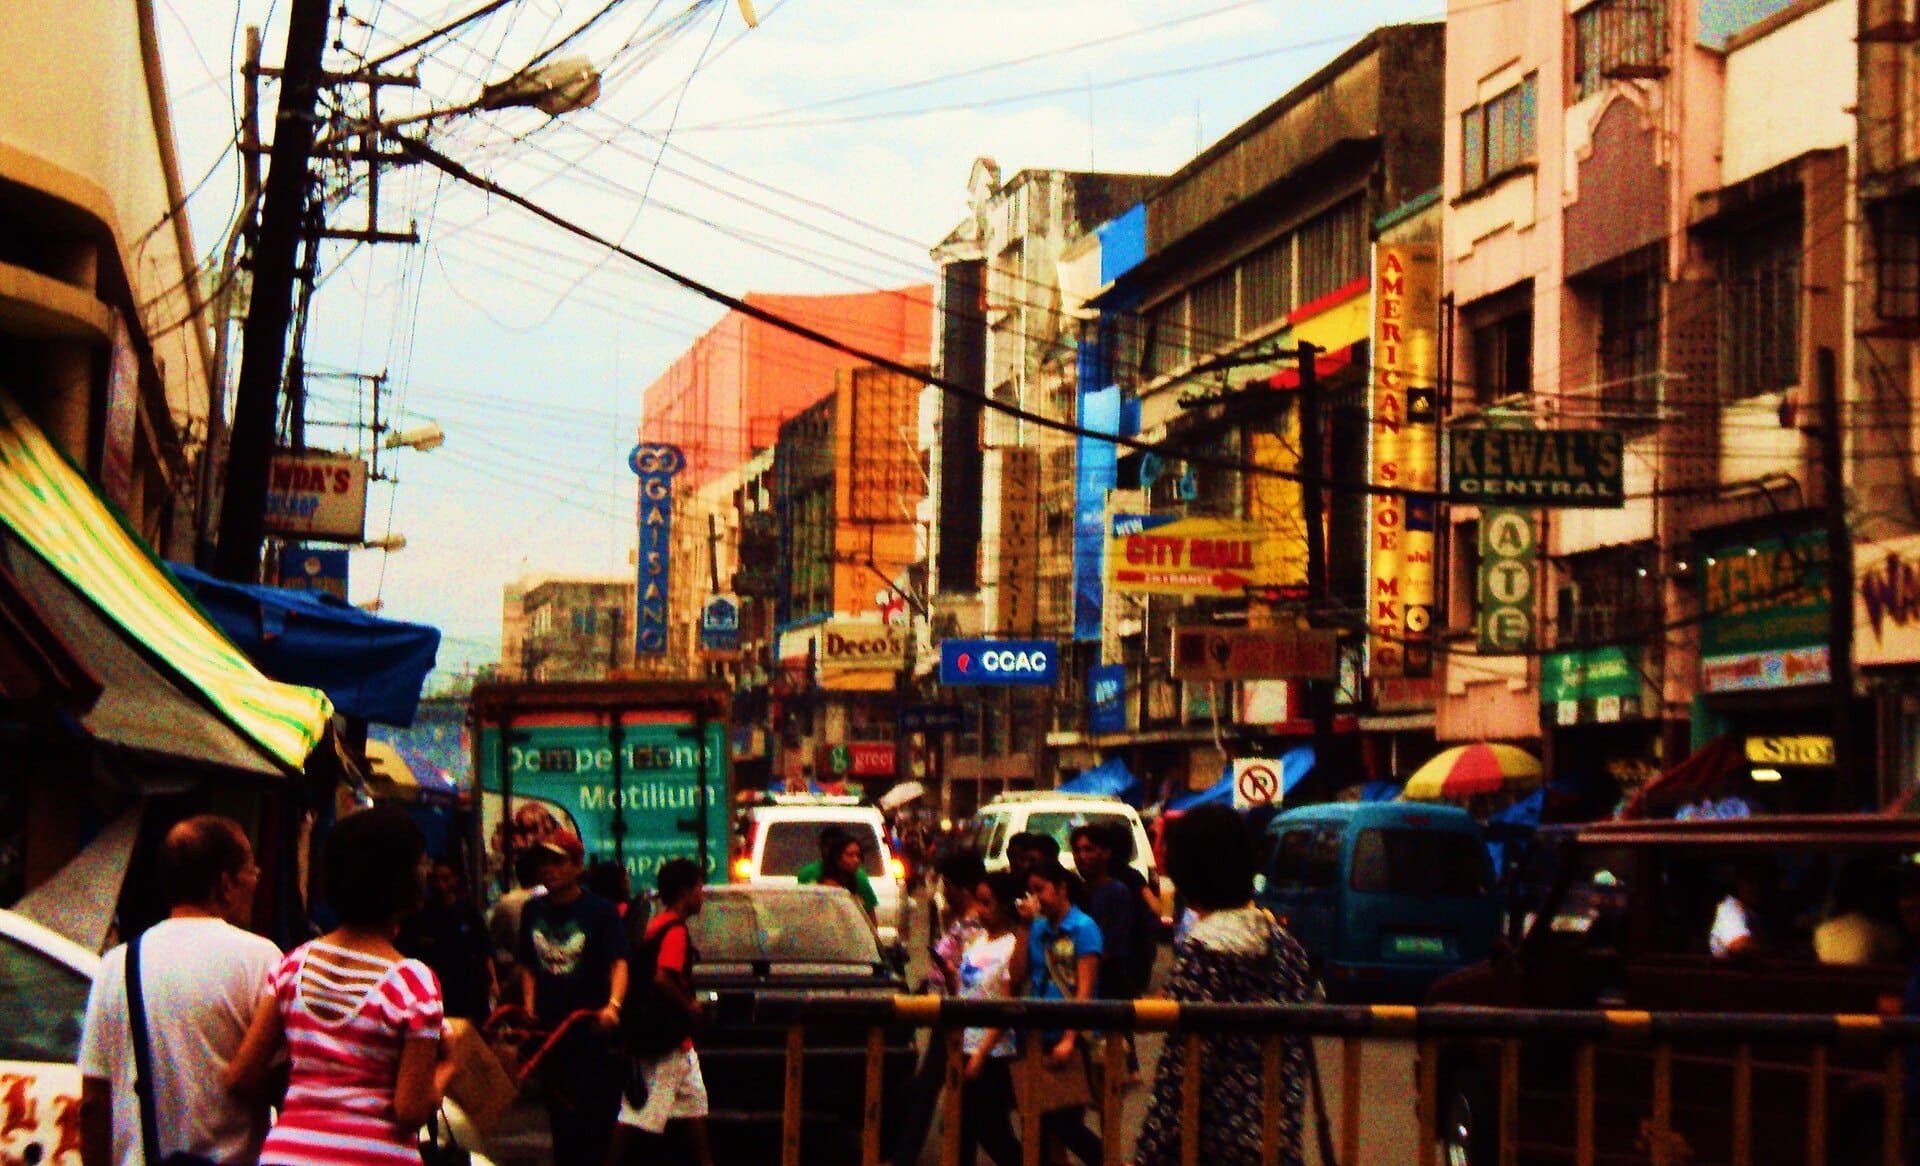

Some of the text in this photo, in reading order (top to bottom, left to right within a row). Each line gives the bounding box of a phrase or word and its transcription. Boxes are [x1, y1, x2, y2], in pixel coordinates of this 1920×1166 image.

[1380, 253, 1403, 434] AMERICAN
[1454, 432, 1616, 478] KEWAL'S
[1378, 463, 1398, 550] SHOE
[1459, 478, 1614, 496] CENTRAL
[643, 479, 667, 648] GAISANO
[1127, 535, 1186, 566] CITY
[579, 783, 716, 809] Motilium
